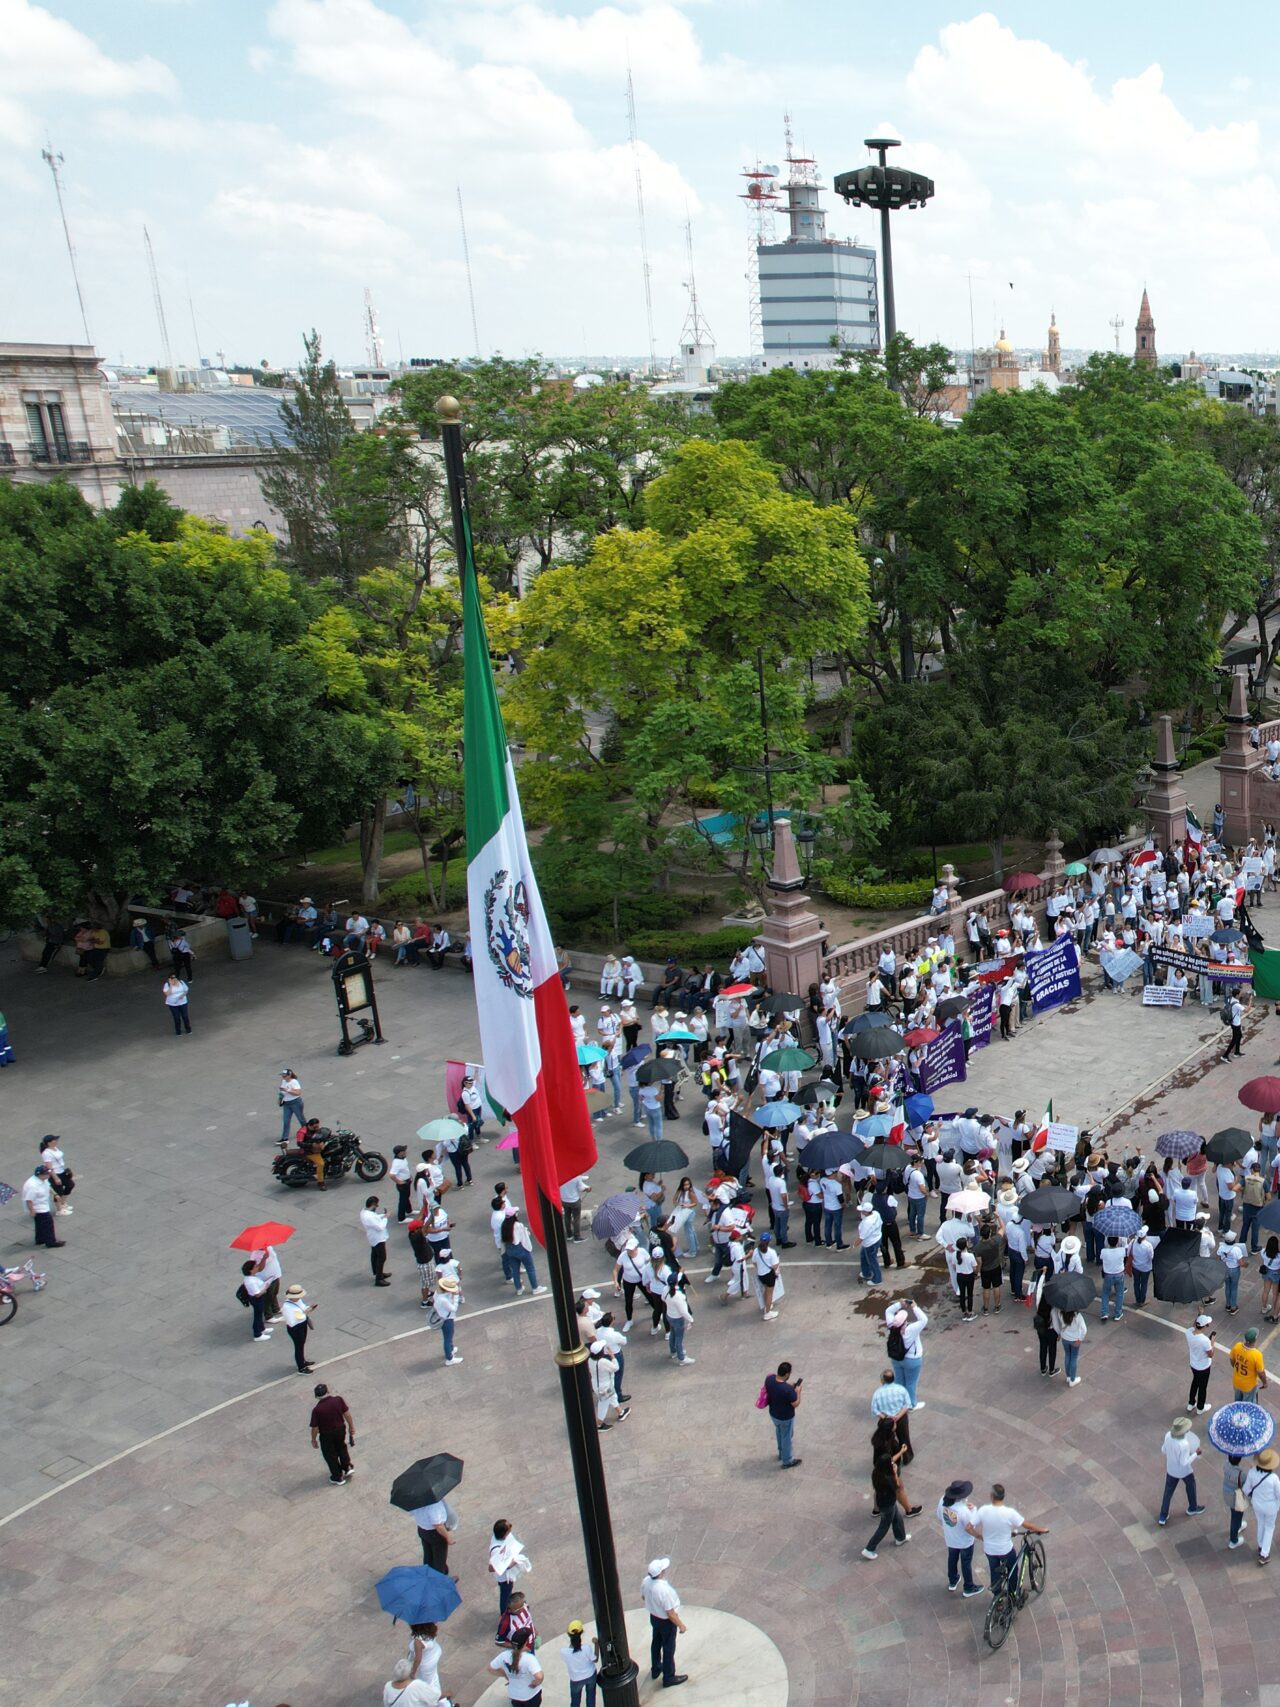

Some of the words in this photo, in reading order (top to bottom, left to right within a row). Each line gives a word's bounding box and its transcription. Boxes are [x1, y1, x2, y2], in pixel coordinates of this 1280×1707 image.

[1055, 967, 1077, 980] JUSTICIA
[1036, 979, 1070, 1002] GRACIAS
[940, 1071, 958, 1083] Judicial
